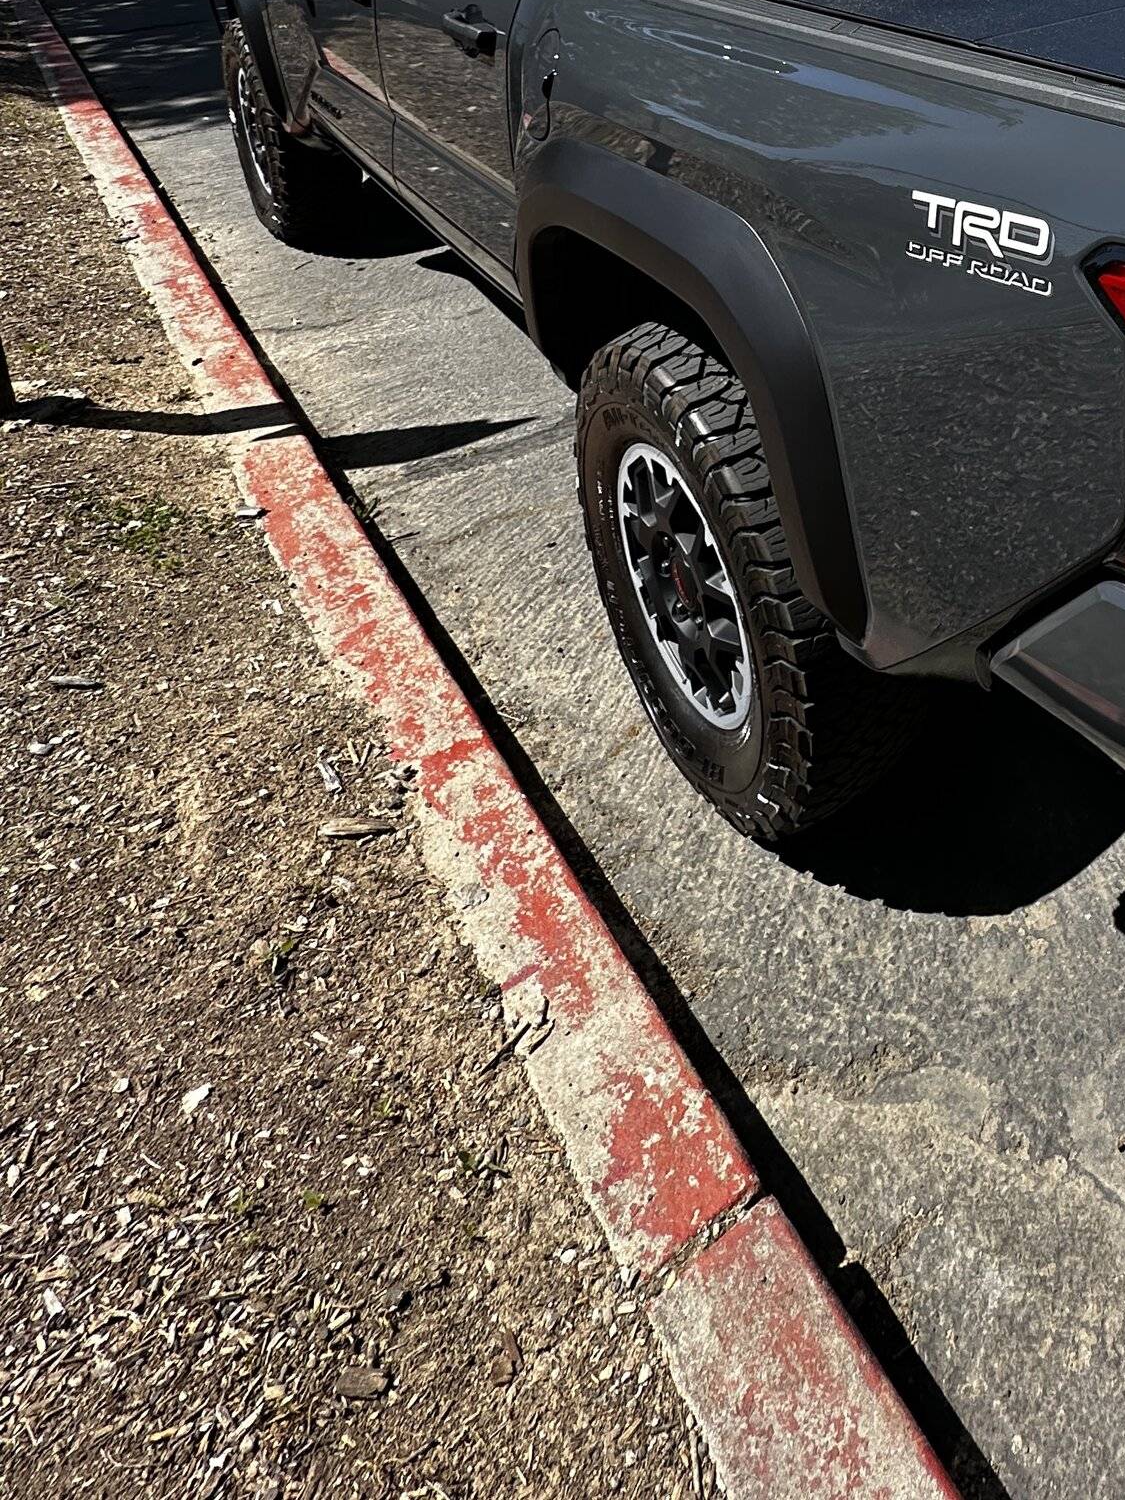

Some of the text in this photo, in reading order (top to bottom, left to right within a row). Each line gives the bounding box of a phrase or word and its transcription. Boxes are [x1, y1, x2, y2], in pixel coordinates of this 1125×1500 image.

[911, 189, 1055, 266] TRD
[905, 240, 1053, 297] OFF ROAD
